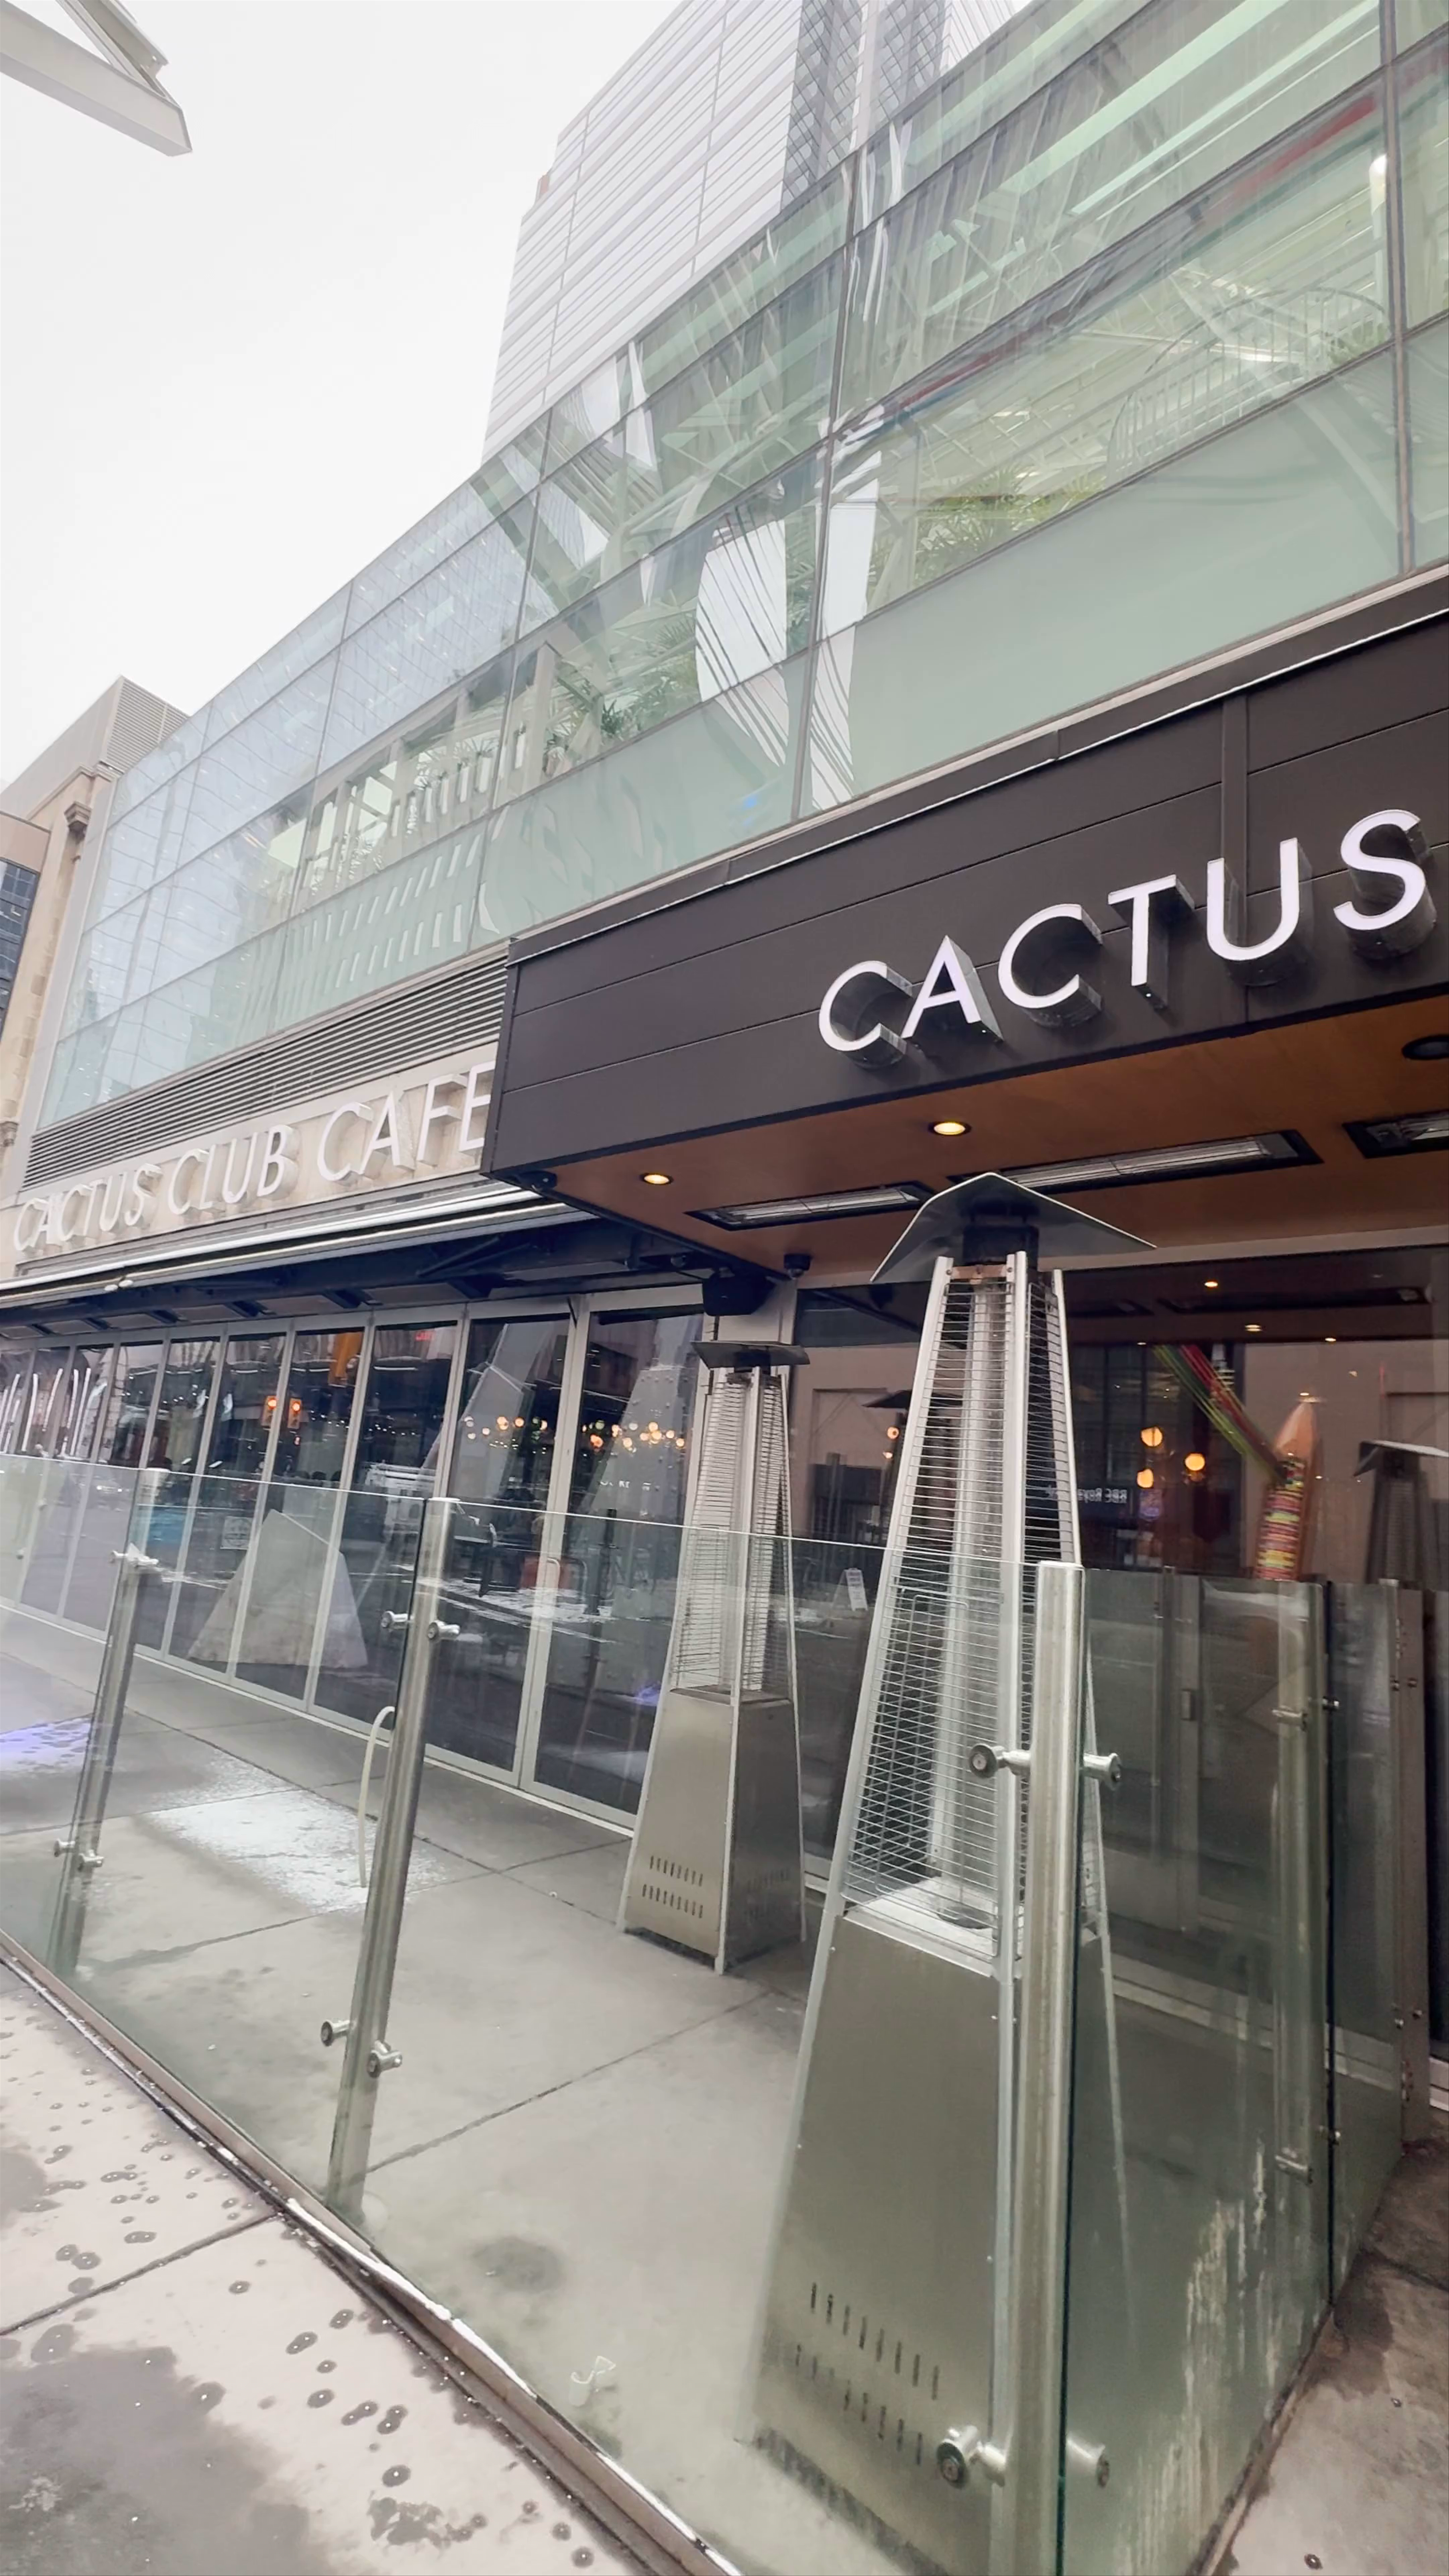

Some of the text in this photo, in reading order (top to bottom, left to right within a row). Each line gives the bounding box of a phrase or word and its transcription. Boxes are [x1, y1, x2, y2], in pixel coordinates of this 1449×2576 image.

[818, 808, 1429, 1055] CACTUS
[14, 1061, 496, 1251] CACTUS CLUB CAFE
